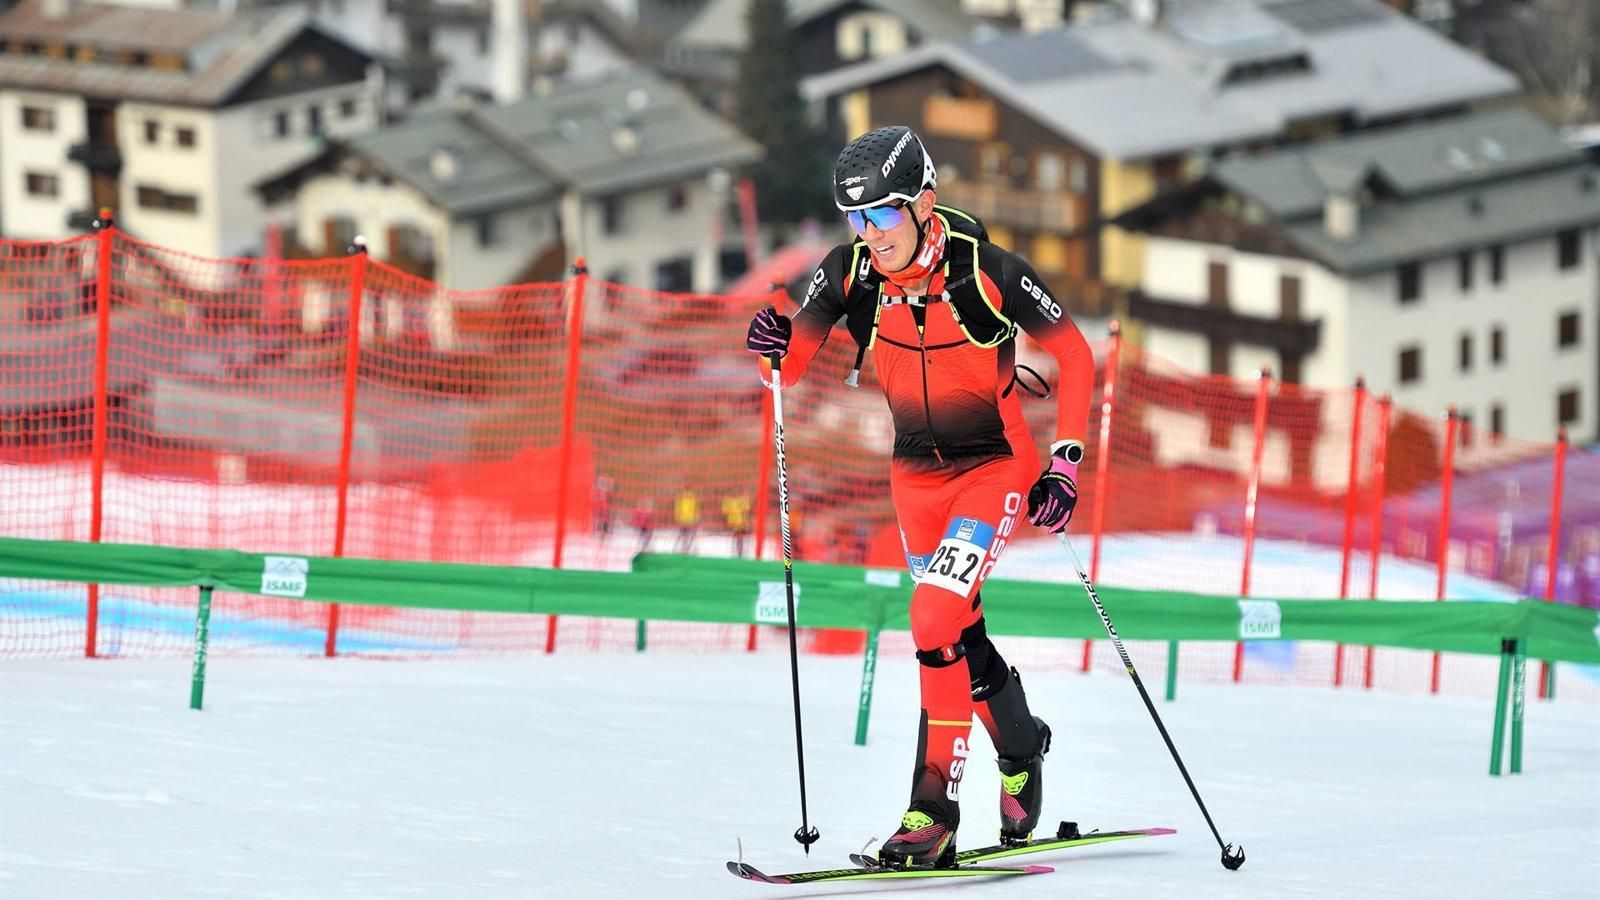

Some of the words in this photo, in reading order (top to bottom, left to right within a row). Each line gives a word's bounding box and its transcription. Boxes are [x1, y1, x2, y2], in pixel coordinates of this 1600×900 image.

[882, 131, 912, 178] DYNAFIT
[927, 545, 979, 585] 25.2
[760, 605, 786, 618] ISM
[946, 736, 970, 802] ESP
